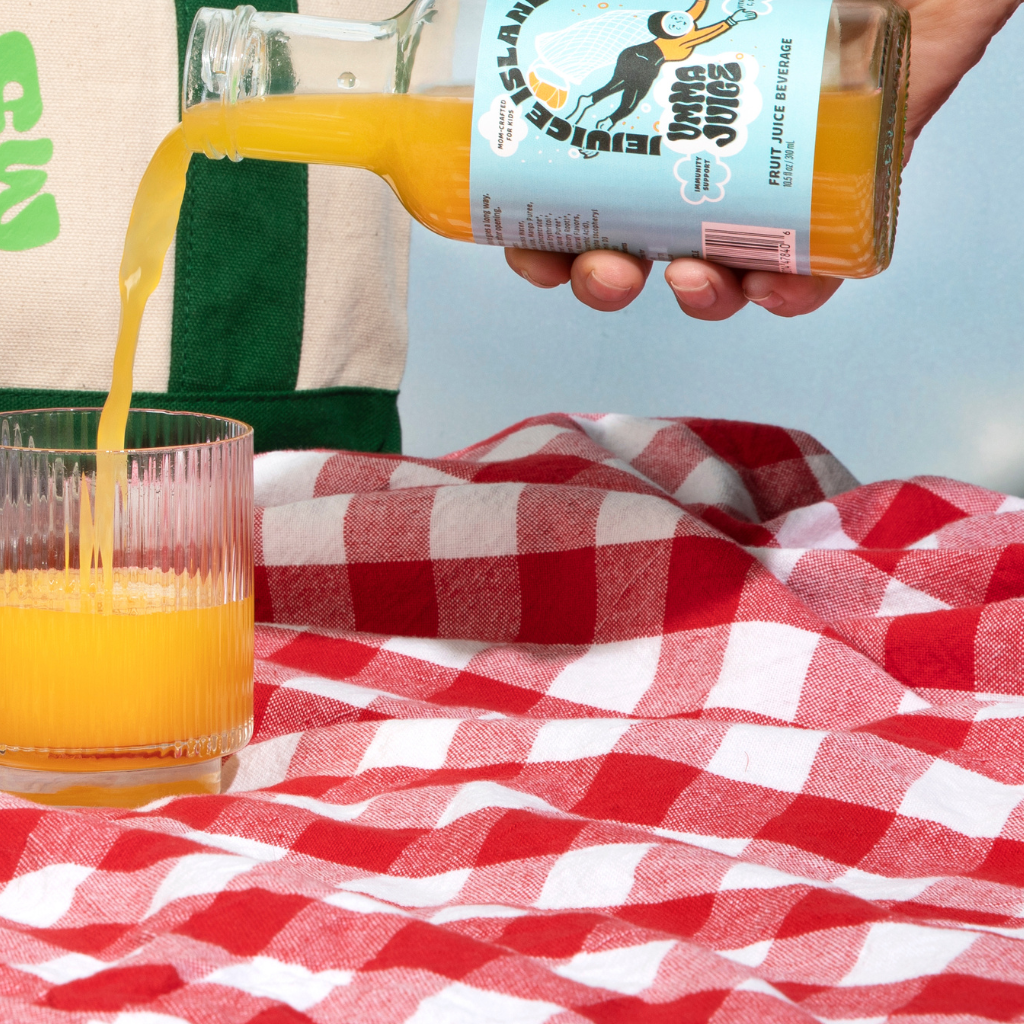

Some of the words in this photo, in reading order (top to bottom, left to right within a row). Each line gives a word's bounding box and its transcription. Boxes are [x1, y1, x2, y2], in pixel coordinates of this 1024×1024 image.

[775, 38, 793, 101] BEVERAGE
[666, 65, 707, 141] UMMA
[703, 62, 742, 148] JUICE
[498, 100, 507, 150] MOM-CRAFTED
[772, 105, 785, 143] JUICE
[703, 160, 711, 191] SUPPORT
[769, 147, 782, 186] FRUIT
[783, 178, 792, 188] 10.5
[482, 194, 490, 209] way.
[483, 210, 491, 224] long
